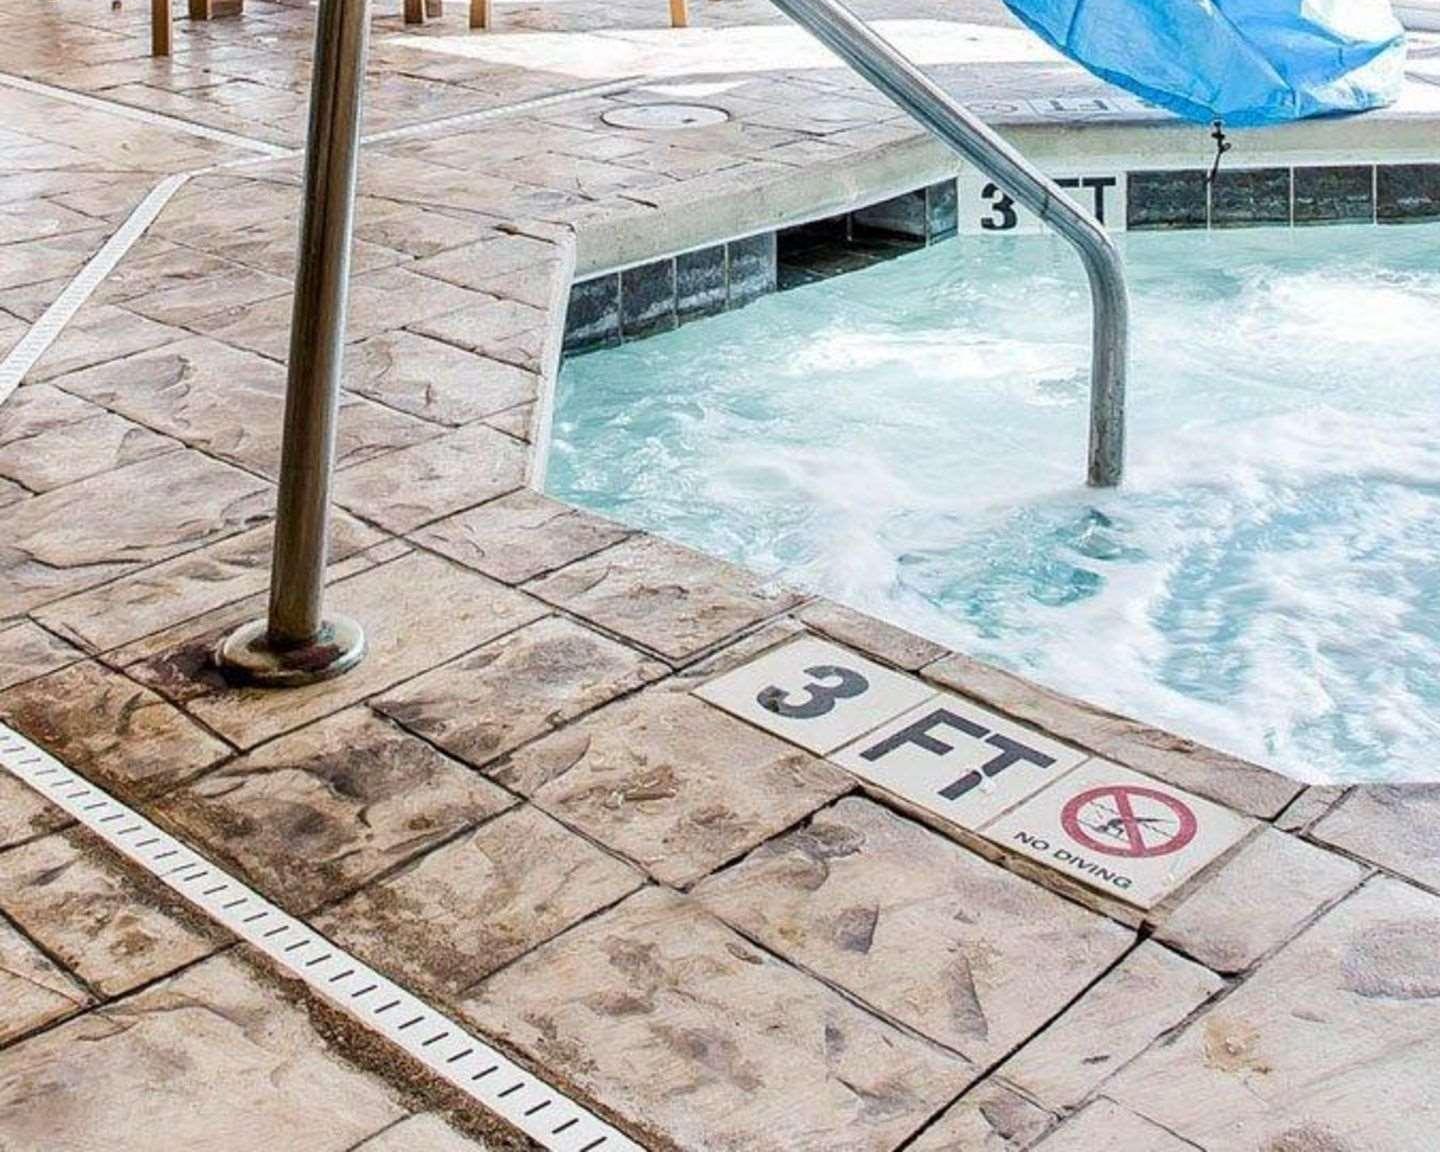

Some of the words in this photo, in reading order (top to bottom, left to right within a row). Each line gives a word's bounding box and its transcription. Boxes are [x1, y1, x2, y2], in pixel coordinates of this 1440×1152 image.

[980, 183, 1018, 230] 3
[1053, 177, 1117, 227] T
[756, 665, 870, 720] 3
[859, 708, 1057, 802] FT
[1013, 831, 1050, 851] NO
[1053, 849, 1133, 890] DIVING
